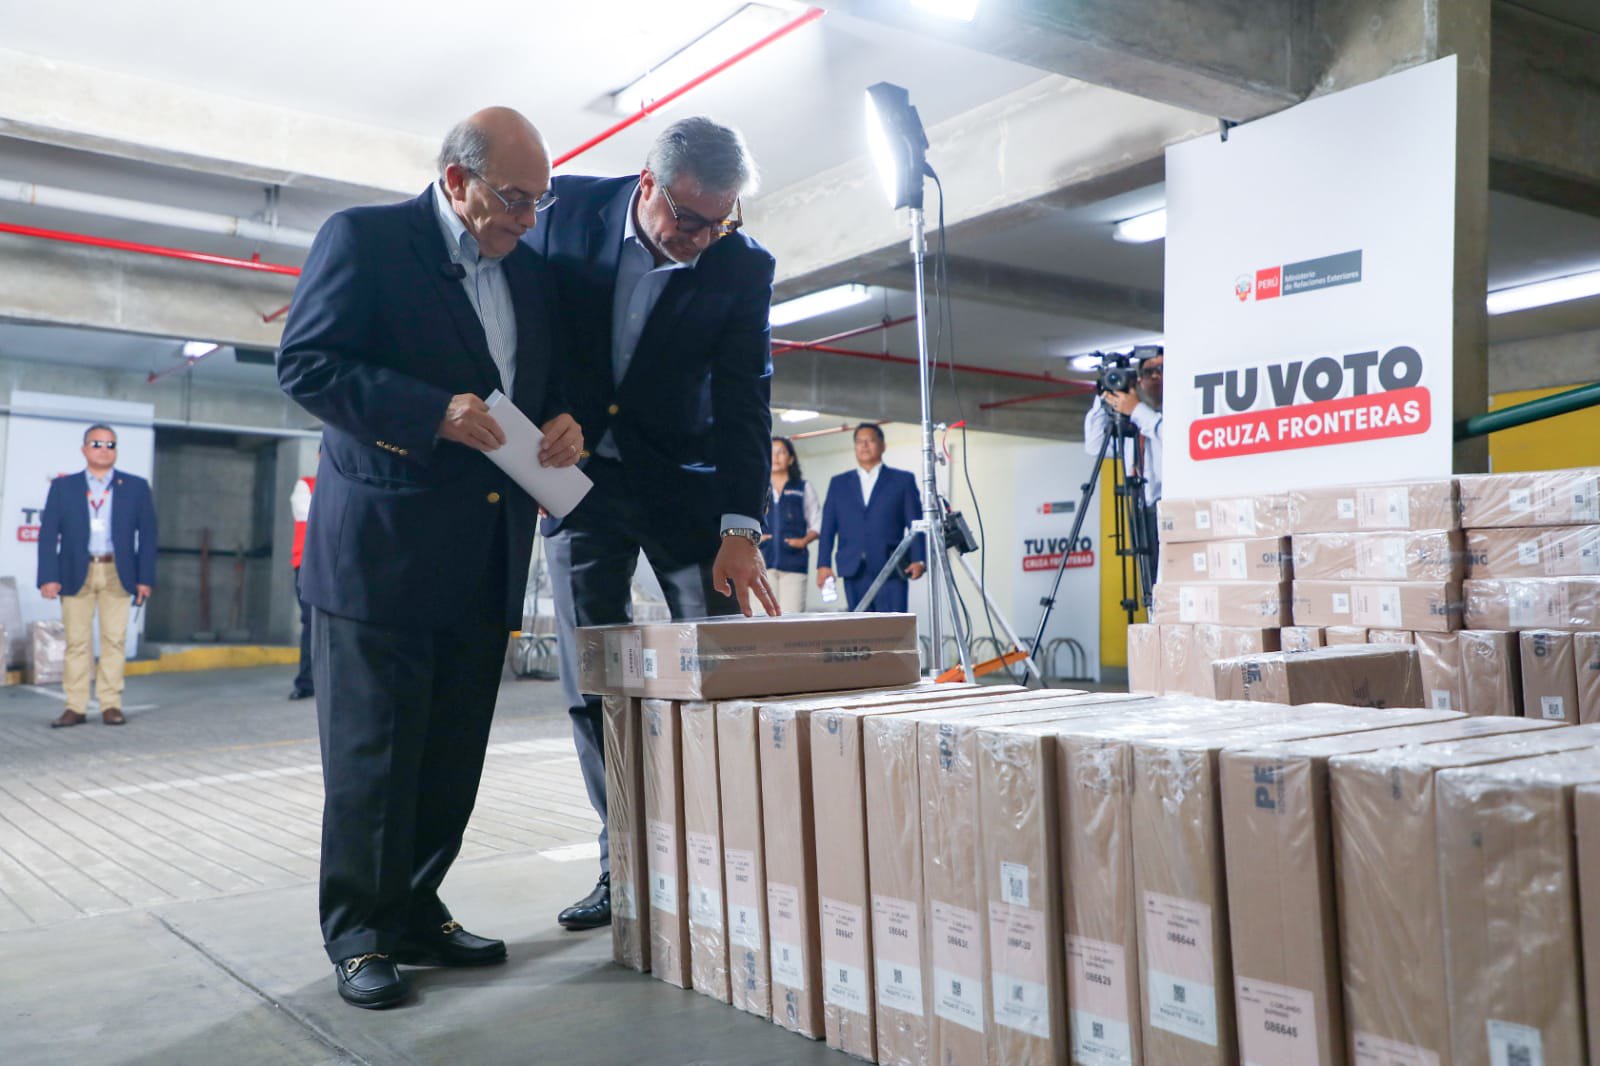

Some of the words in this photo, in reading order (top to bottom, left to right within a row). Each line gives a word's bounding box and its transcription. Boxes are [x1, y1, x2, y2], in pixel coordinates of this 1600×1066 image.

[1257, 276, 1279, 291] PERÚ
[1284, 271, 1316, 283] Ministerio
[1284, 283, 1294, 291] de
[1293, 277, 1327, 289] Relaciones
[1327, 271, 1360, 283] Exteriores
[1194, 367, 1258, 415] TU
[1267, 345, 1423, 408] VOTO
[1197, 421, 1271, 451] CRUZA
[1278, 399, 1421, 441] FRONTERAS
[1024, 539, 1045, 555] TU
